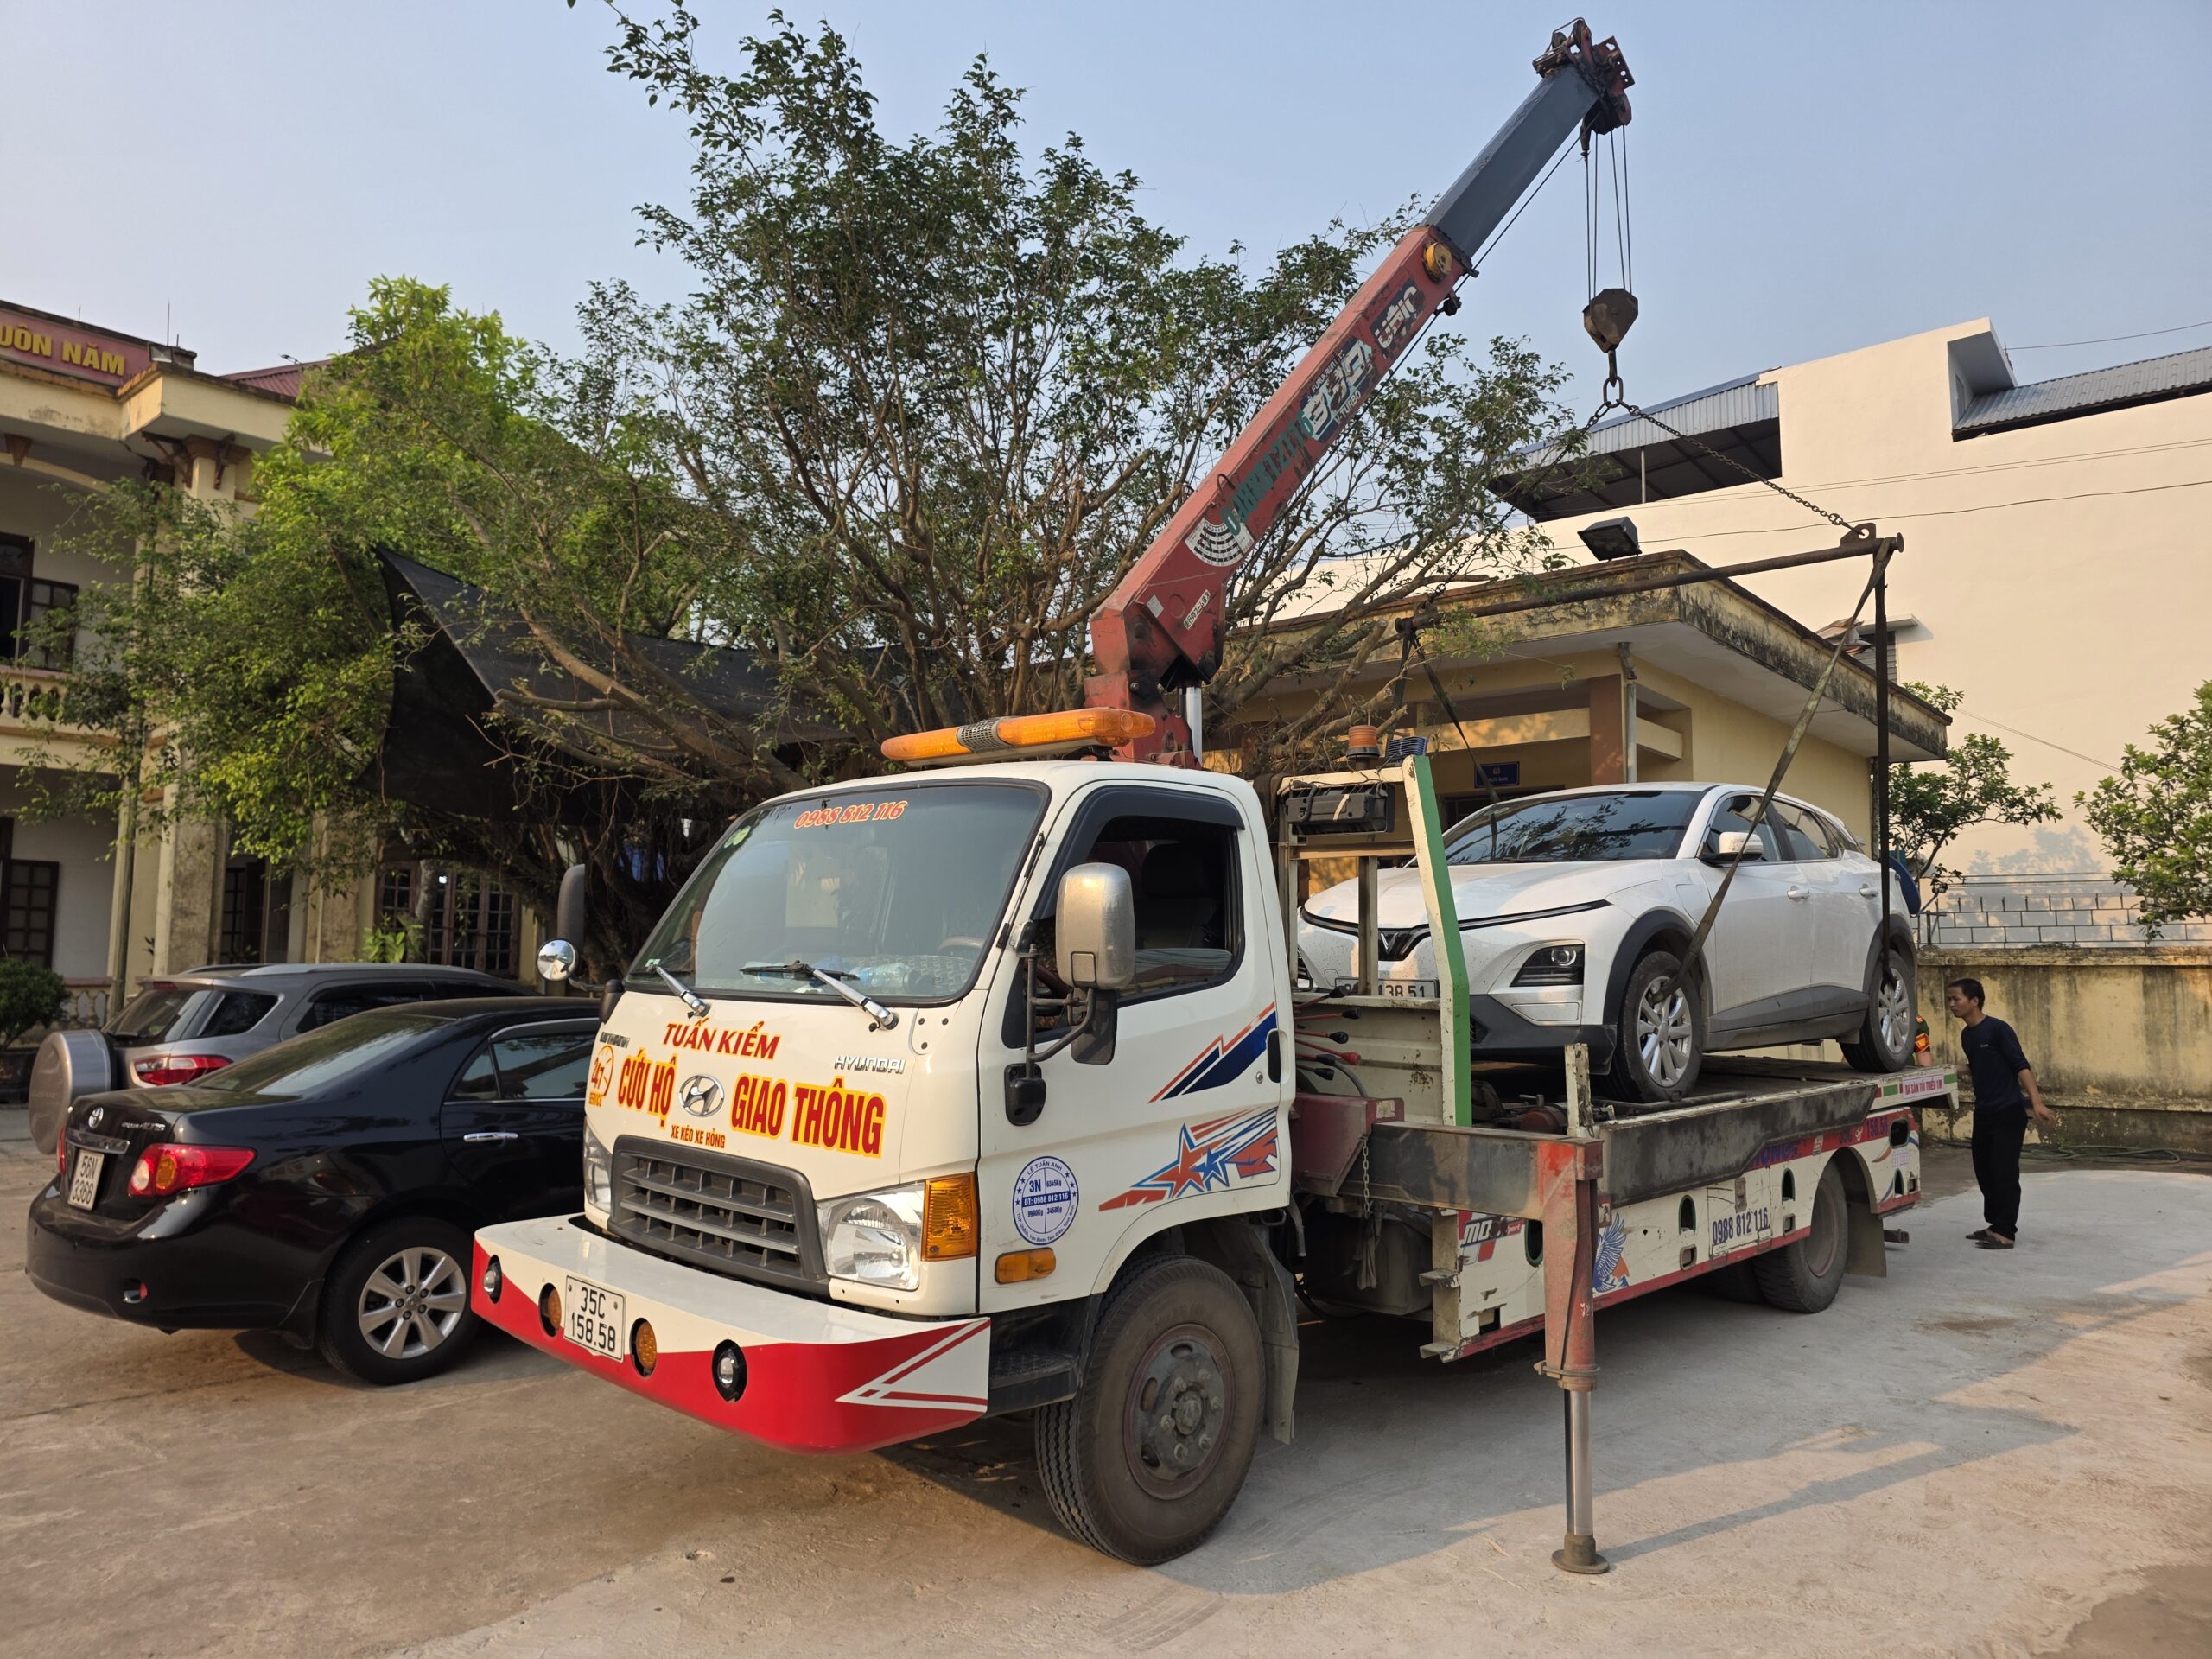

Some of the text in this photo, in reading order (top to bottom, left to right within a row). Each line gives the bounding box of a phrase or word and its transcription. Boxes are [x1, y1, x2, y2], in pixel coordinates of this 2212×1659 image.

[62, 342, 125, 376] NĂM
[794, 801, 907, 829] 0988 812 116
[663, 1017, 780, 1059] TUẤN KIỂM
[834, 1055, 906, 1074] HYUNDAI
[618, 1049, 885, 1154] CỨU HỘ GIAO THÔNG
[671, 1124, 726, 1148] XE KÉO XE HỎNG
[1029, 1179, 1041, 1192] 3N
[1047, 1193, 1058, 1202] 812
[1058, 1192, 1069, 1201] 116
[1713, 1207, 1769, 1244] 0988 812 116
[580, 1287, 607, 1319] 35C
[571, 1312, 616, 1353] 158.58
